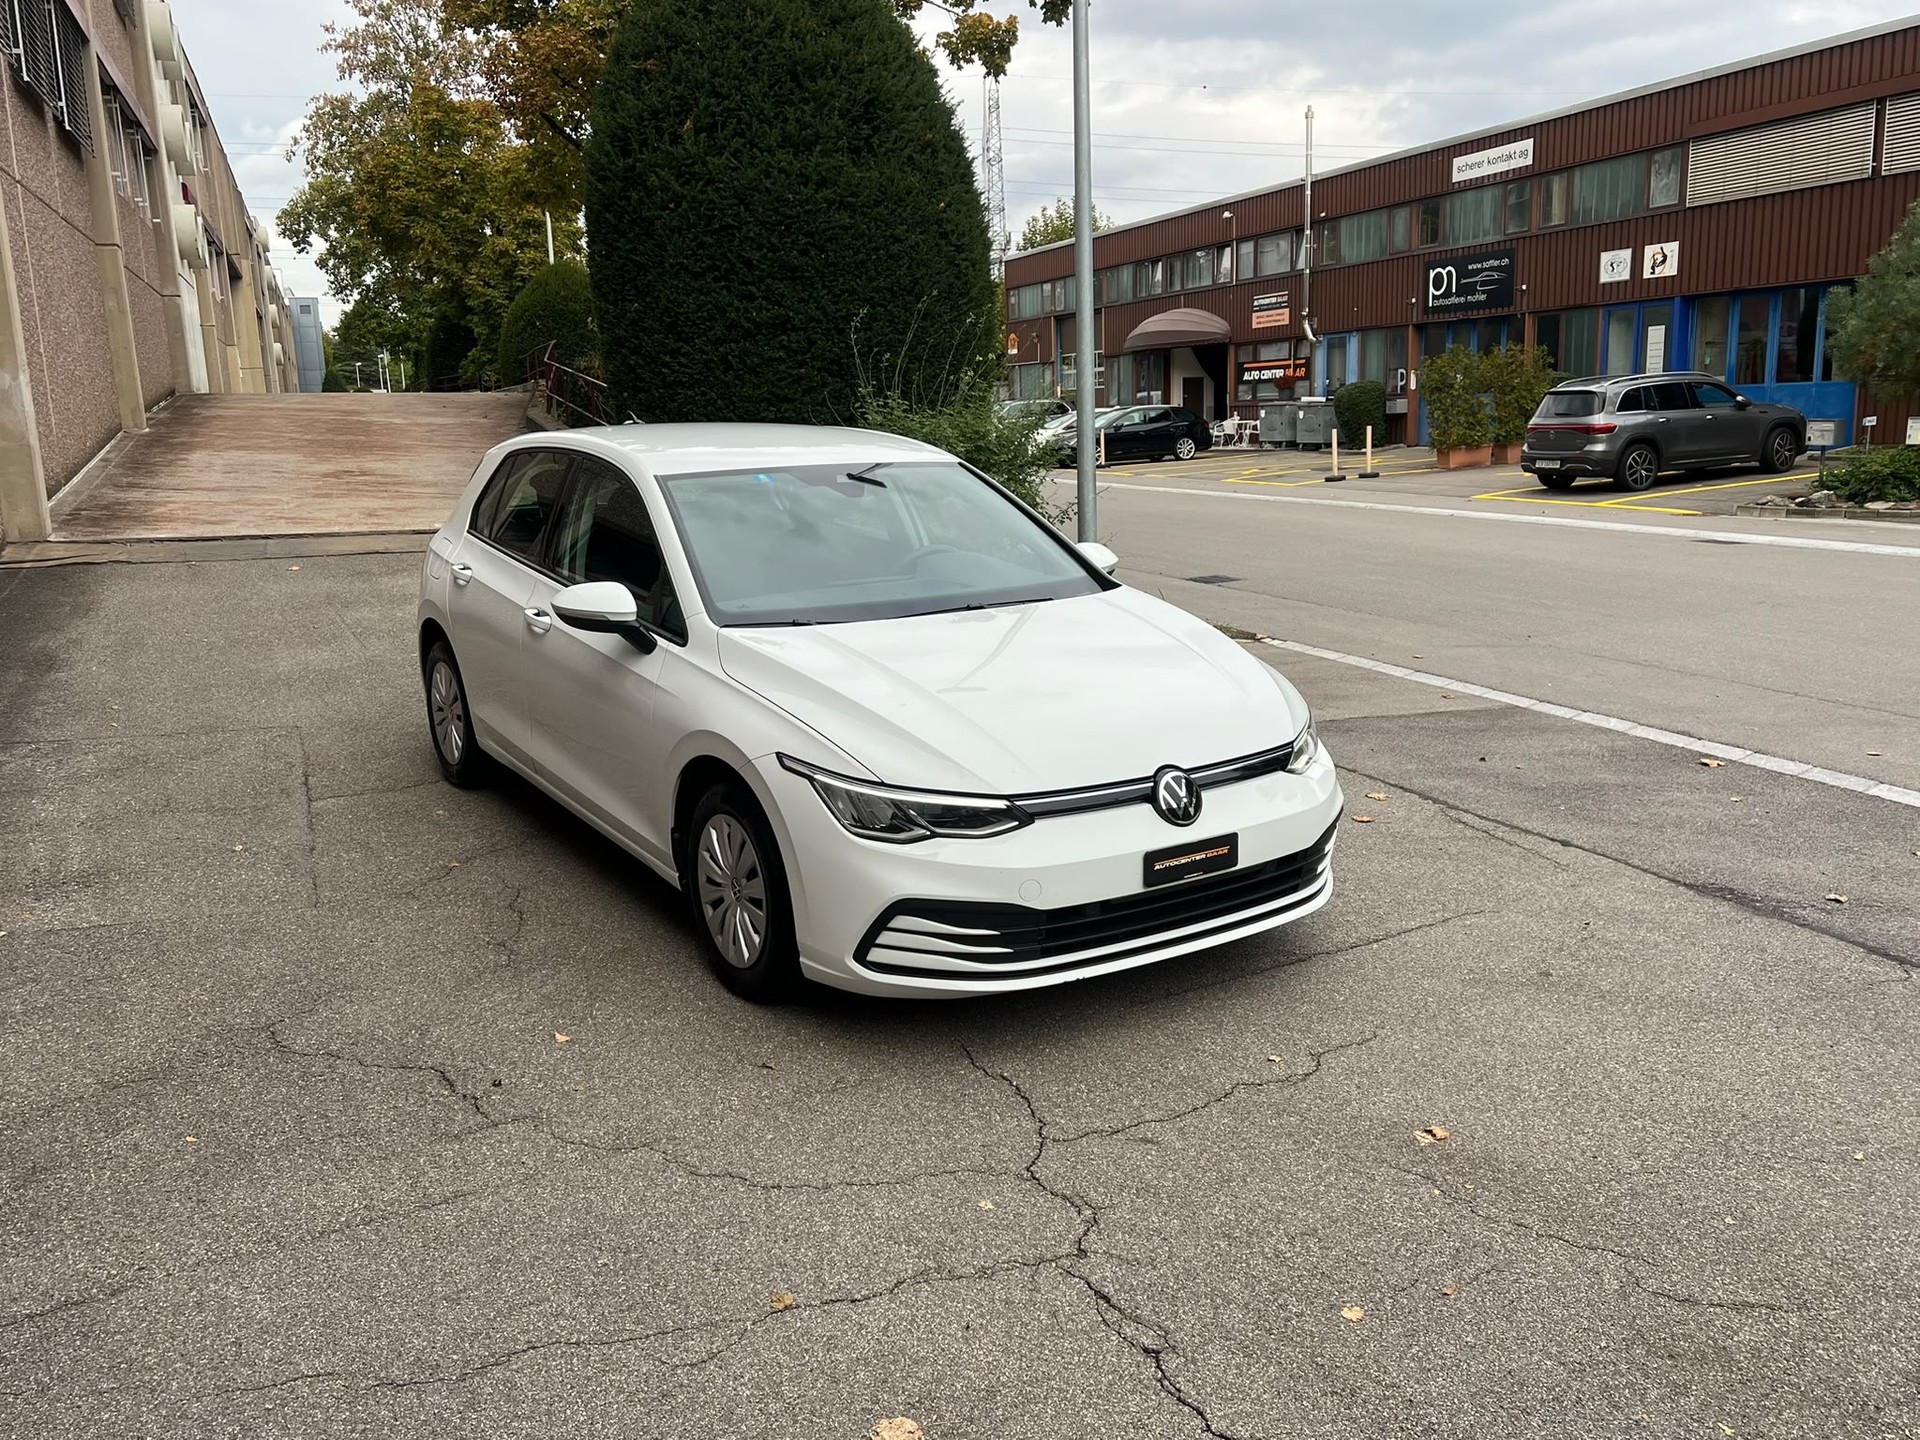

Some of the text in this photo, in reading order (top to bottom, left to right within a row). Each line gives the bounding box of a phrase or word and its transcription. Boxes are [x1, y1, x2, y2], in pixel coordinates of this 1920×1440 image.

[1456, 148, 1529, 174] scherer kontakt ag
[1242, 370, 1260, 381] AUTO
[1260, 368, 1285, 380] CENTER
[1153, 848, 1229, 871] AUTOCENTER BAAR
